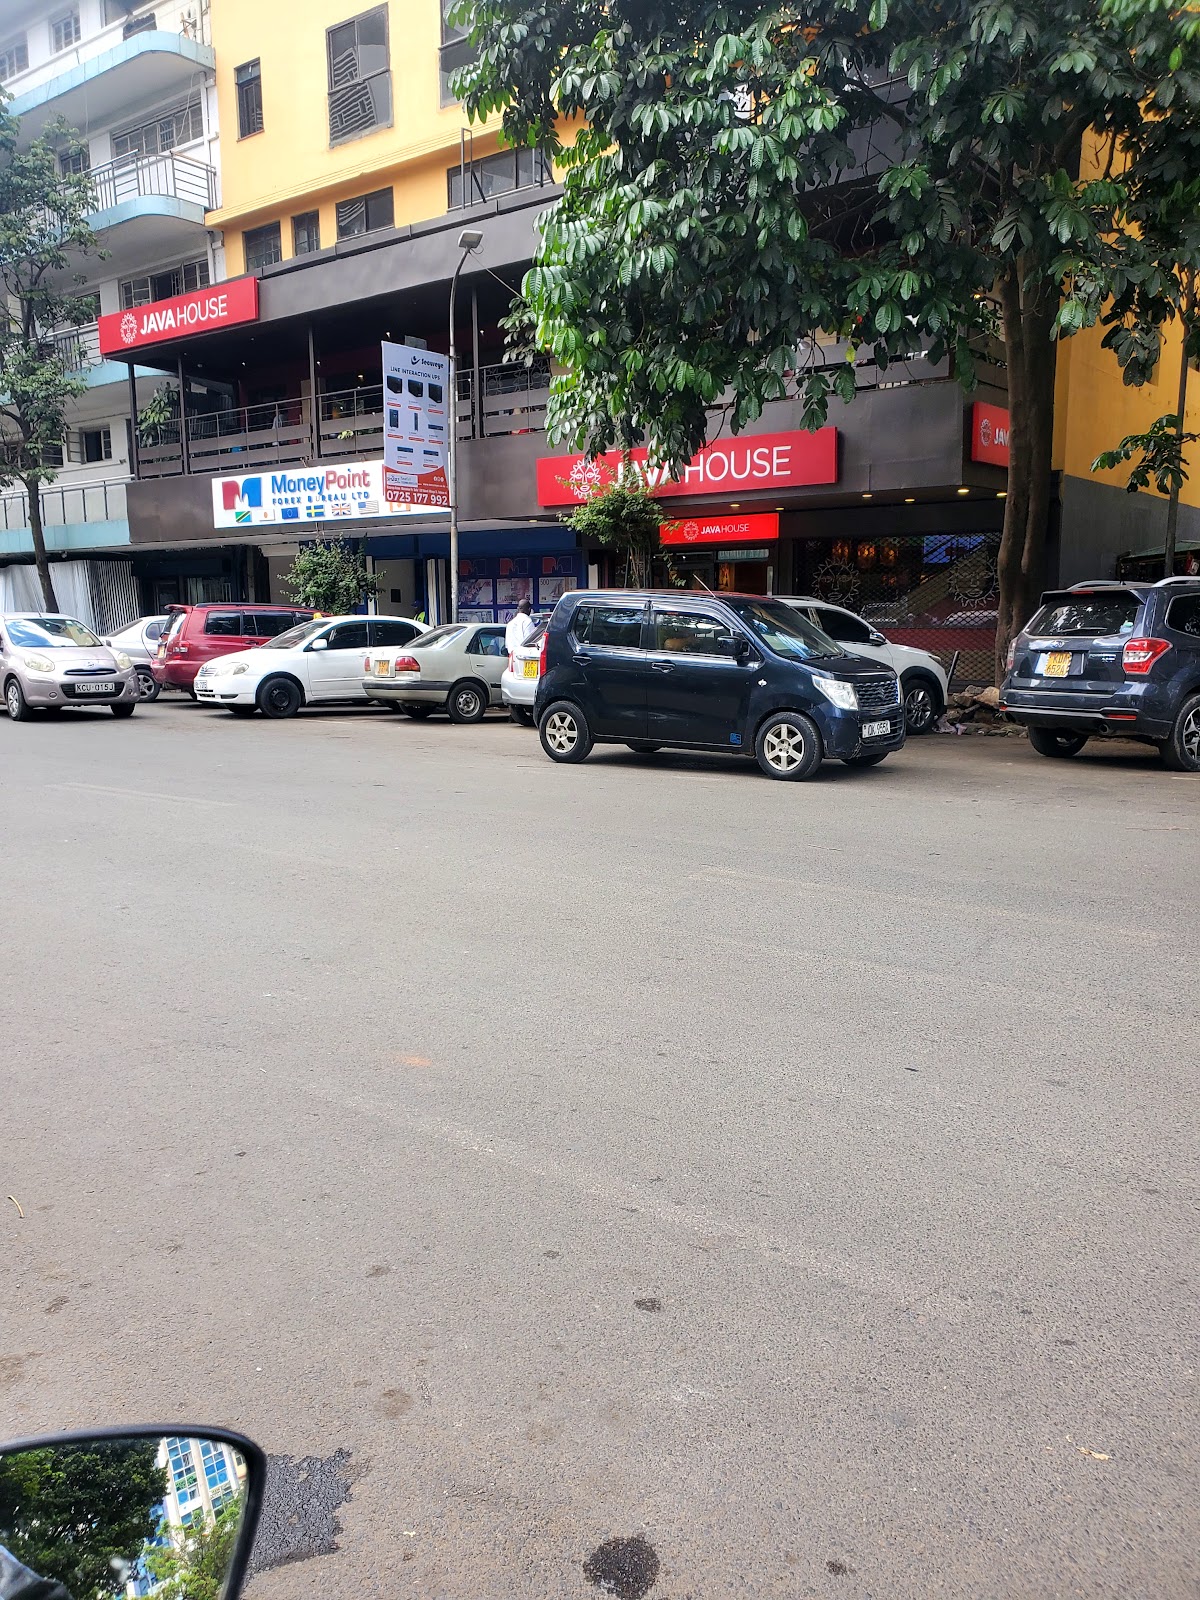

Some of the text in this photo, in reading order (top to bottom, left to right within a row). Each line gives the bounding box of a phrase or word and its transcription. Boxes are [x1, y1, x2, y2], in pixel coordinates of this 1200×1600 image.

[272, 491, 370, 505] FOREX BUREAU LTD
[386, 490, 411, 502] 0725
[413, 493, 428, 503] 177
[430, 495, 448, 505] 992
